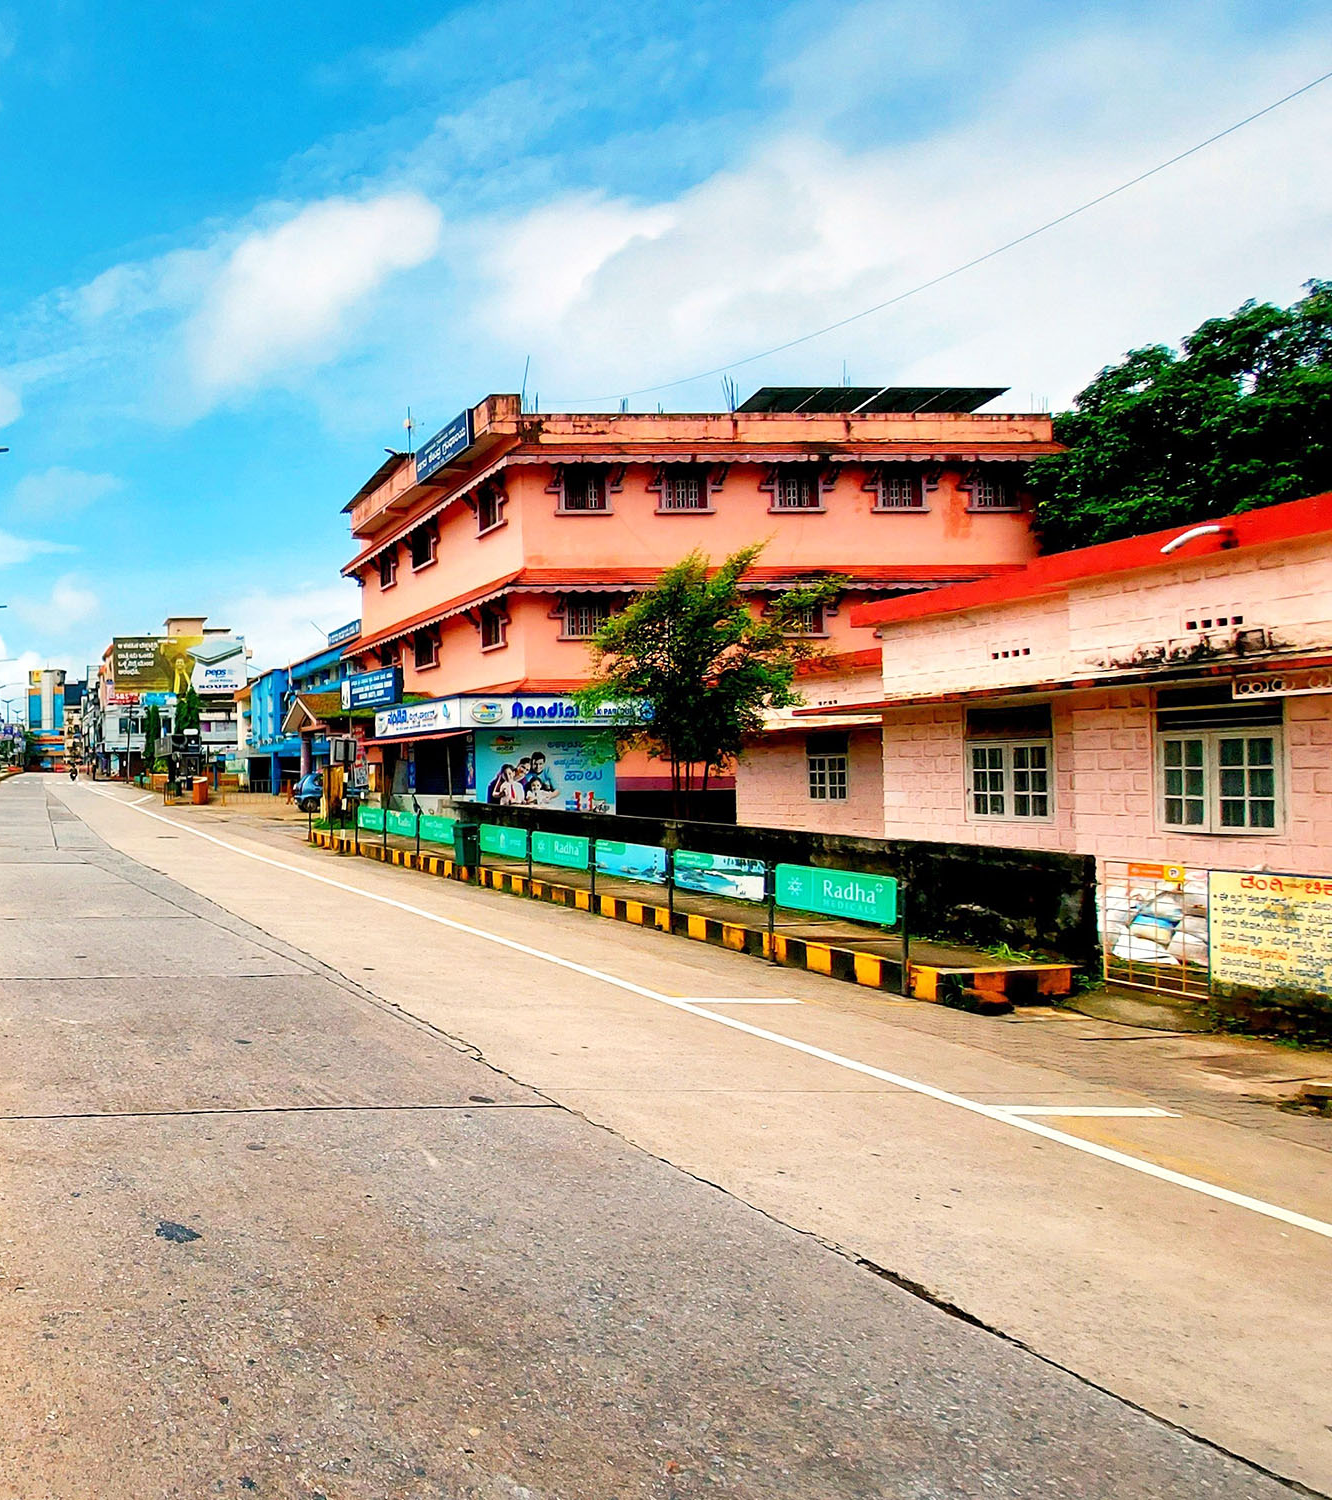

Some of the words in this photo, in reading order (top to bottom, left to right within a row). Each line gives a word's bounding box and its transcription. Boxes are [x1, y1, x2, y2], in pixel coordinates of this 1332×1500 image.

[564, 769, 603, 781] ಹಾಲು
[554, 841, 580, 856] Radha
[823, 880, 876, 904] Radha
[823, 899, 877, 915] MEDICALS
